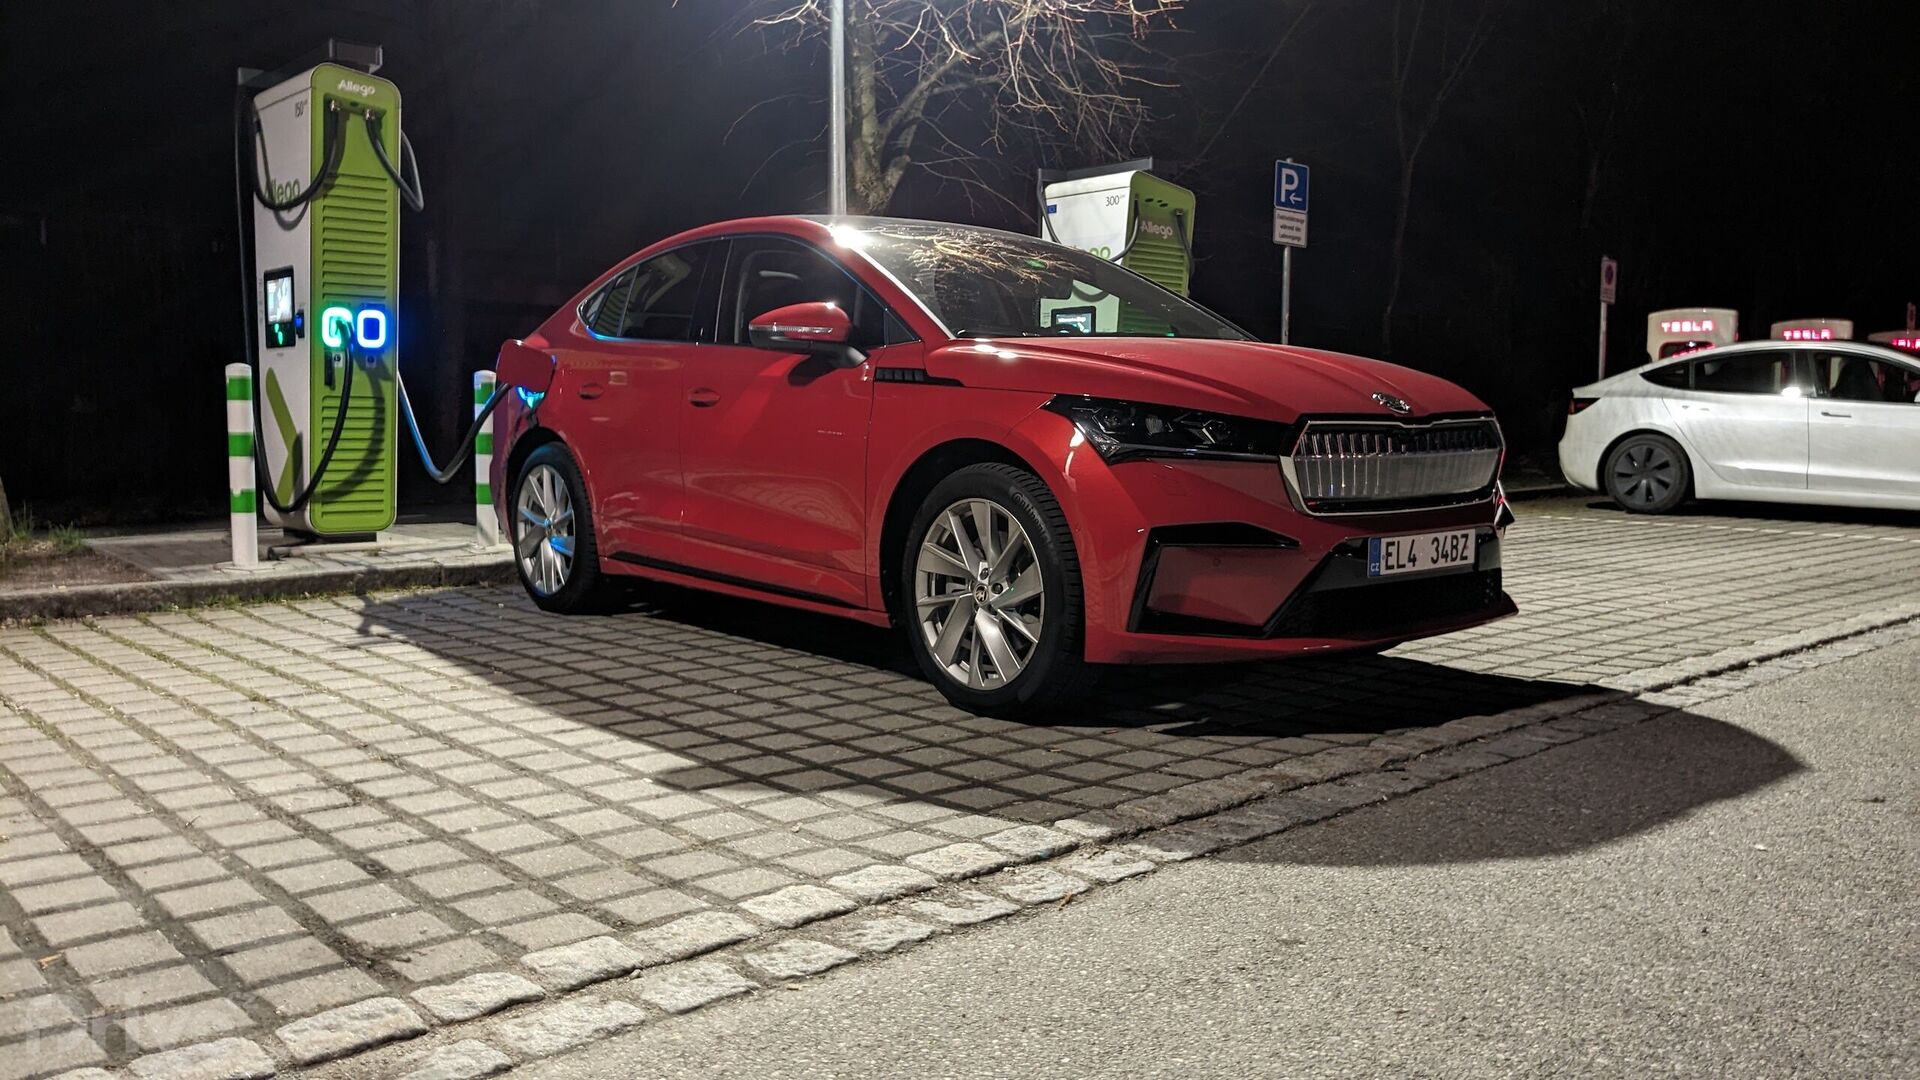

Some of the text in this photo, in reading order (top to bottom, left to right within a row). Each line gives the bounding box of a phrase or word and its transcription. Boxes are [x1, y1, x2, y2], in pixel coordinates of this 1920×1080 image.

[337, 79, 376, 97] Allego
[1280, 167, 1299, 203] P
[1105, 194, 1120, 207] 300
[1140, 220, 1173, 240] Allego
[1660, 319, 1713, 333] TESLA
[1782, 328, 1832, 341] TESLA
[1385, 533, 1469, 571] EL4 34BZ
[1370, 562, 1380, 572] CZ
